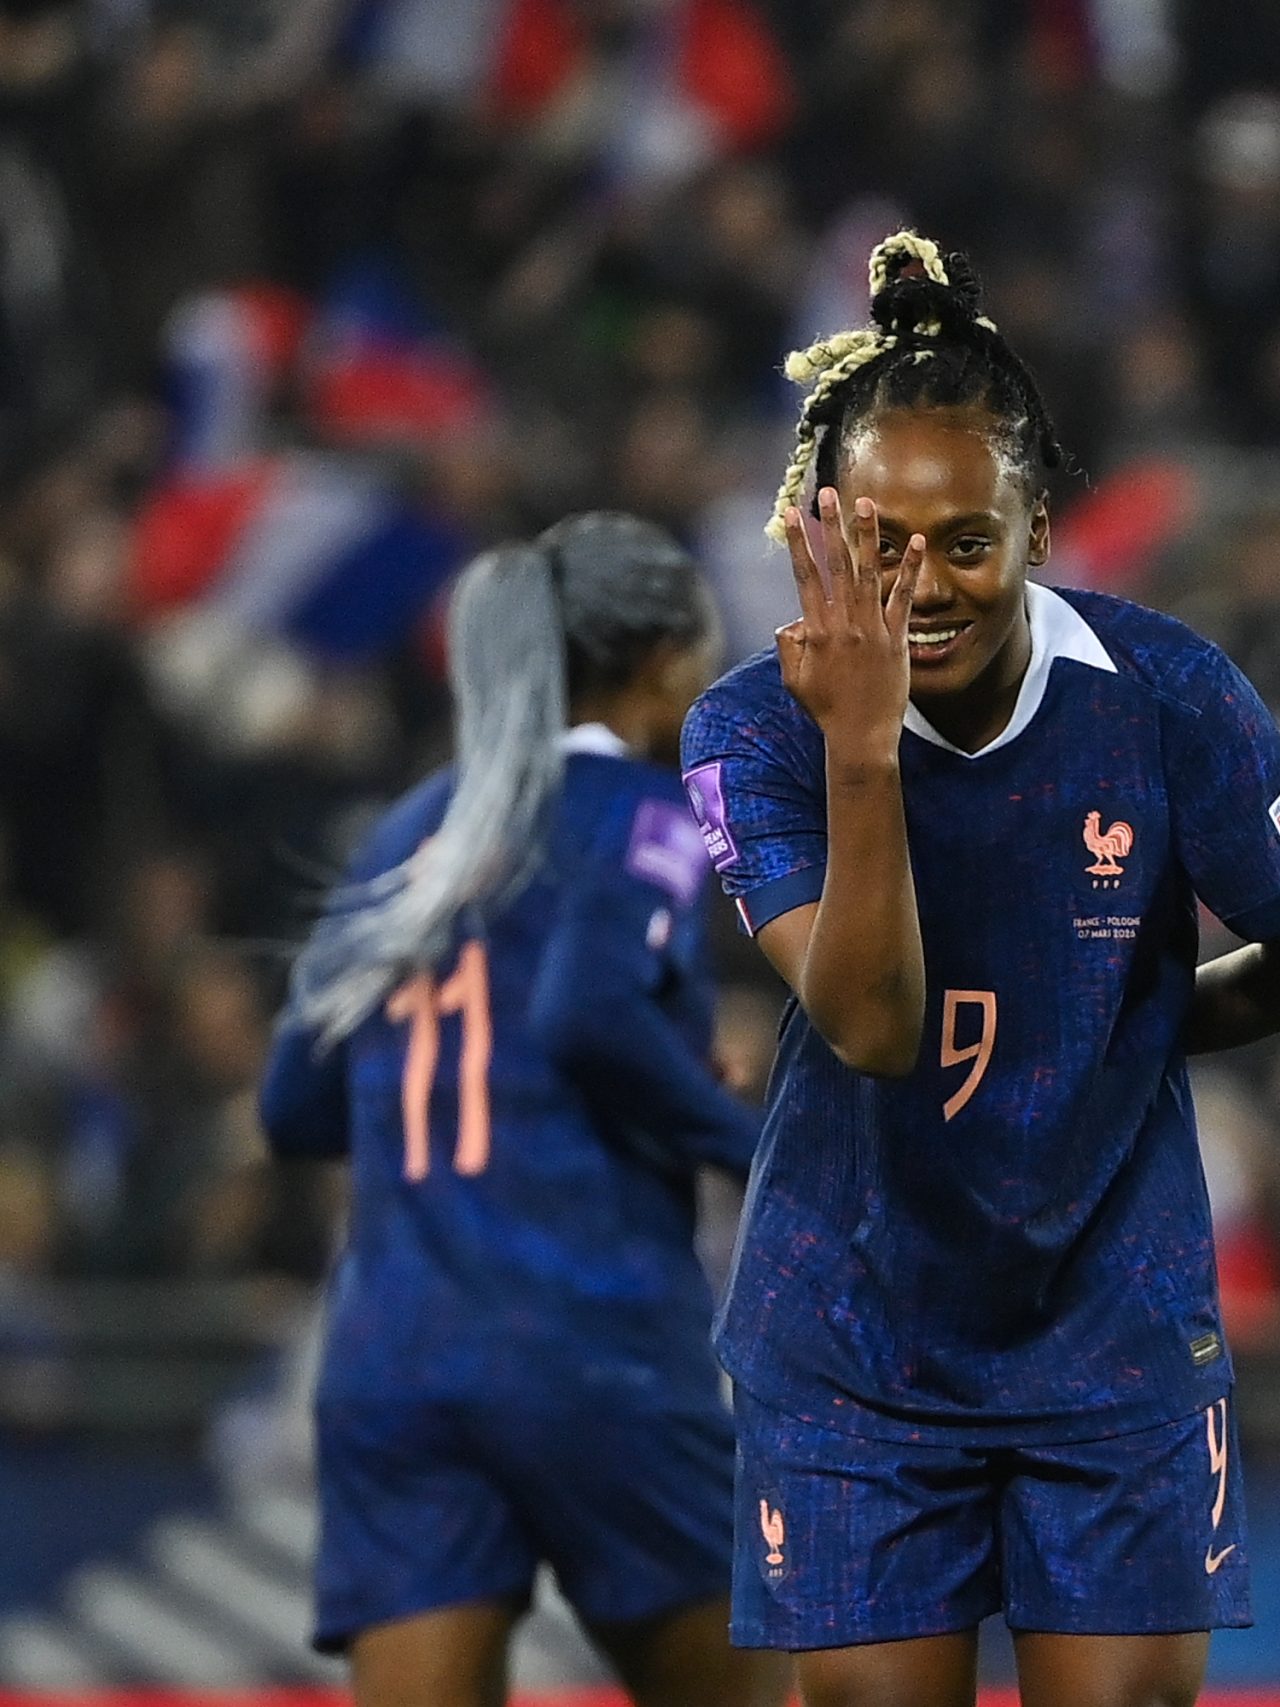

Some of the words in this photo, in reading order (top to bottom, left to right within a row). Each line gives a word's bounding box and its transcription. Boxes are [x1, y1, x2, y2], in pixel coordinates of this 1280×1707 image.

[1072, 917, 1100, 928] FRANCE
[1107, 916, 1141, 926] POLOGNE
[1078, 930, 1090, 939] 07
[1091, 929, 1112, 938] MARS
[1113, 929, 1136, 938] 2026
[386, 936, 492, 1183] 11
[941, 989, 997, 1122] 9
